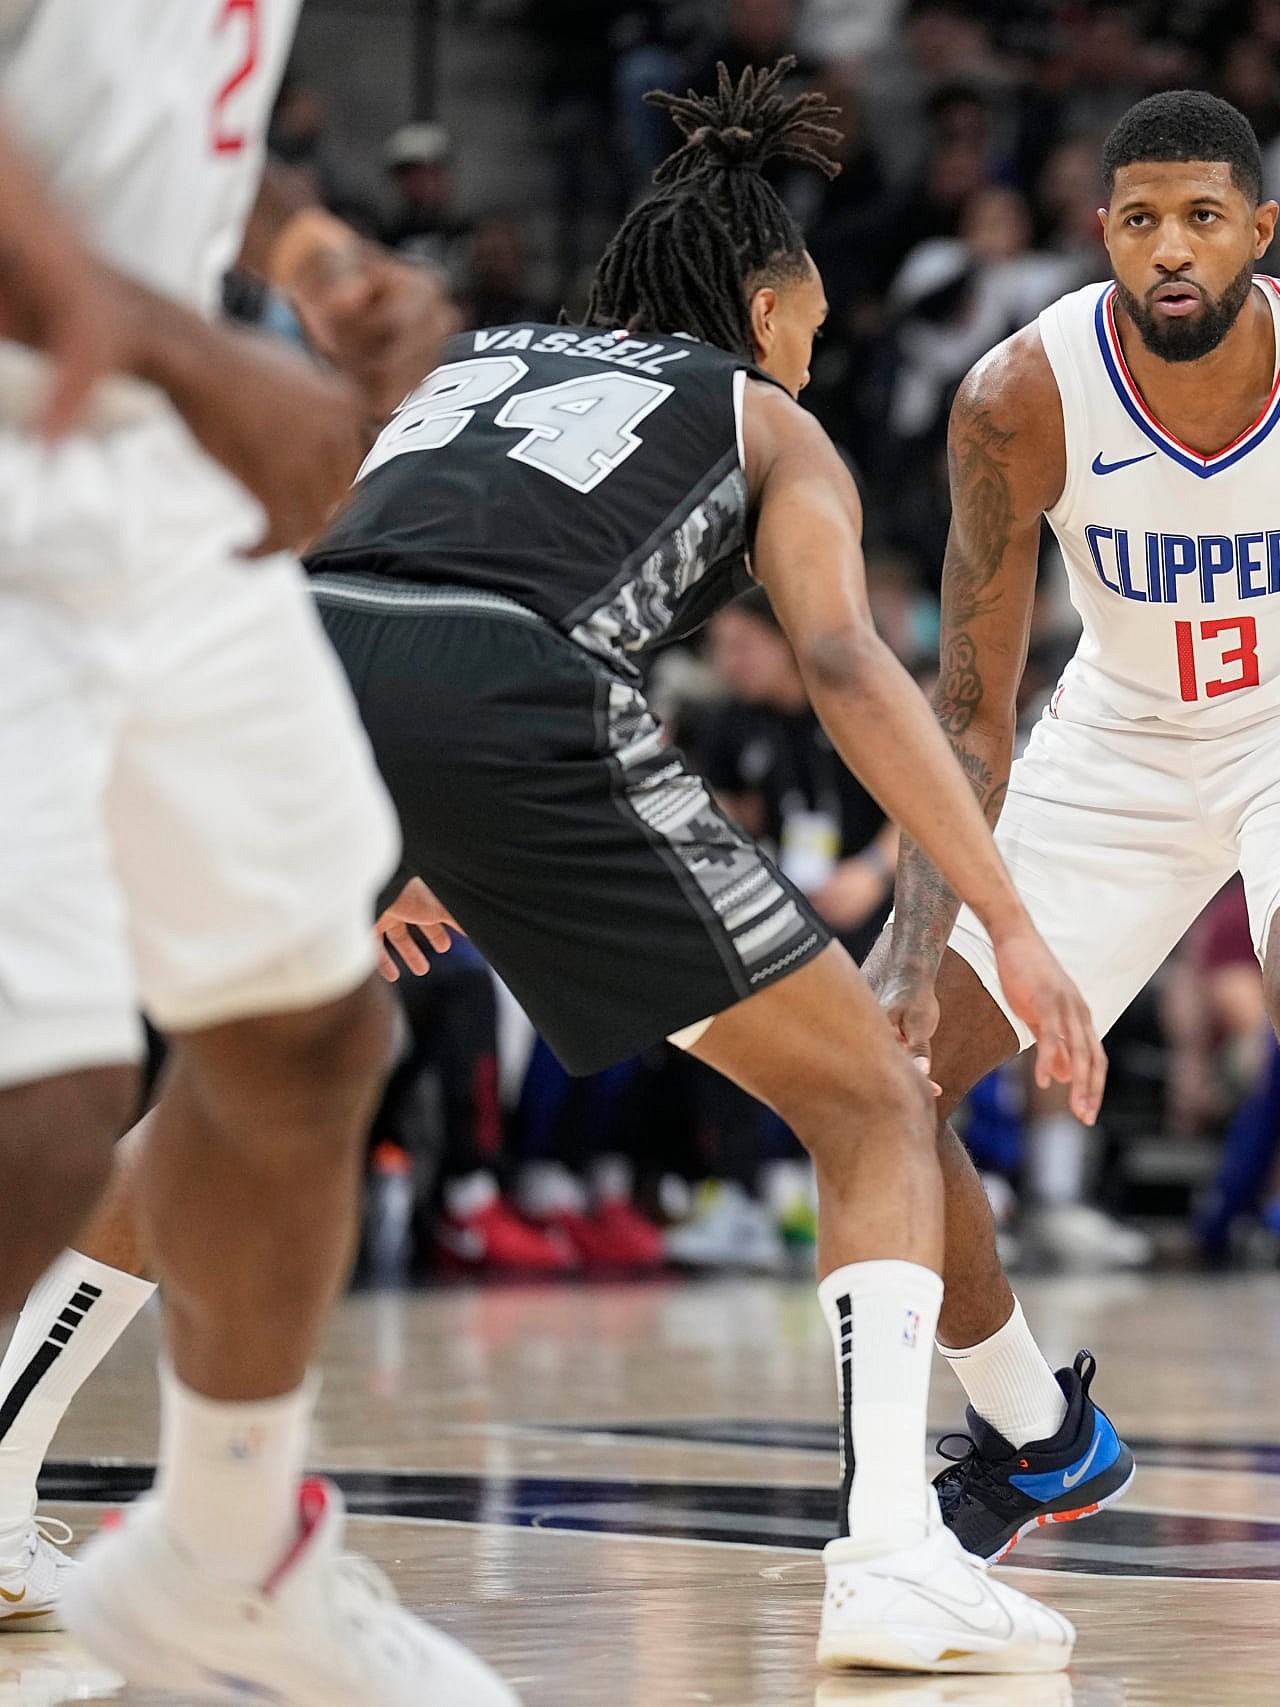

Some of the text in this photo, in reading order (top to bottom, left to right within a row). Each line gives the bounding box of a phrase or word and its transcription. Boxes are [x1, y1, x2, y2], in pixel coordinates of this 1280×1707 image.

[210, 0, 258, 154] 2
[474, 329, 690, 375] VASSELL
[350, 355, 675, 494] 24
[1174, 616, 1260, 702] 13
